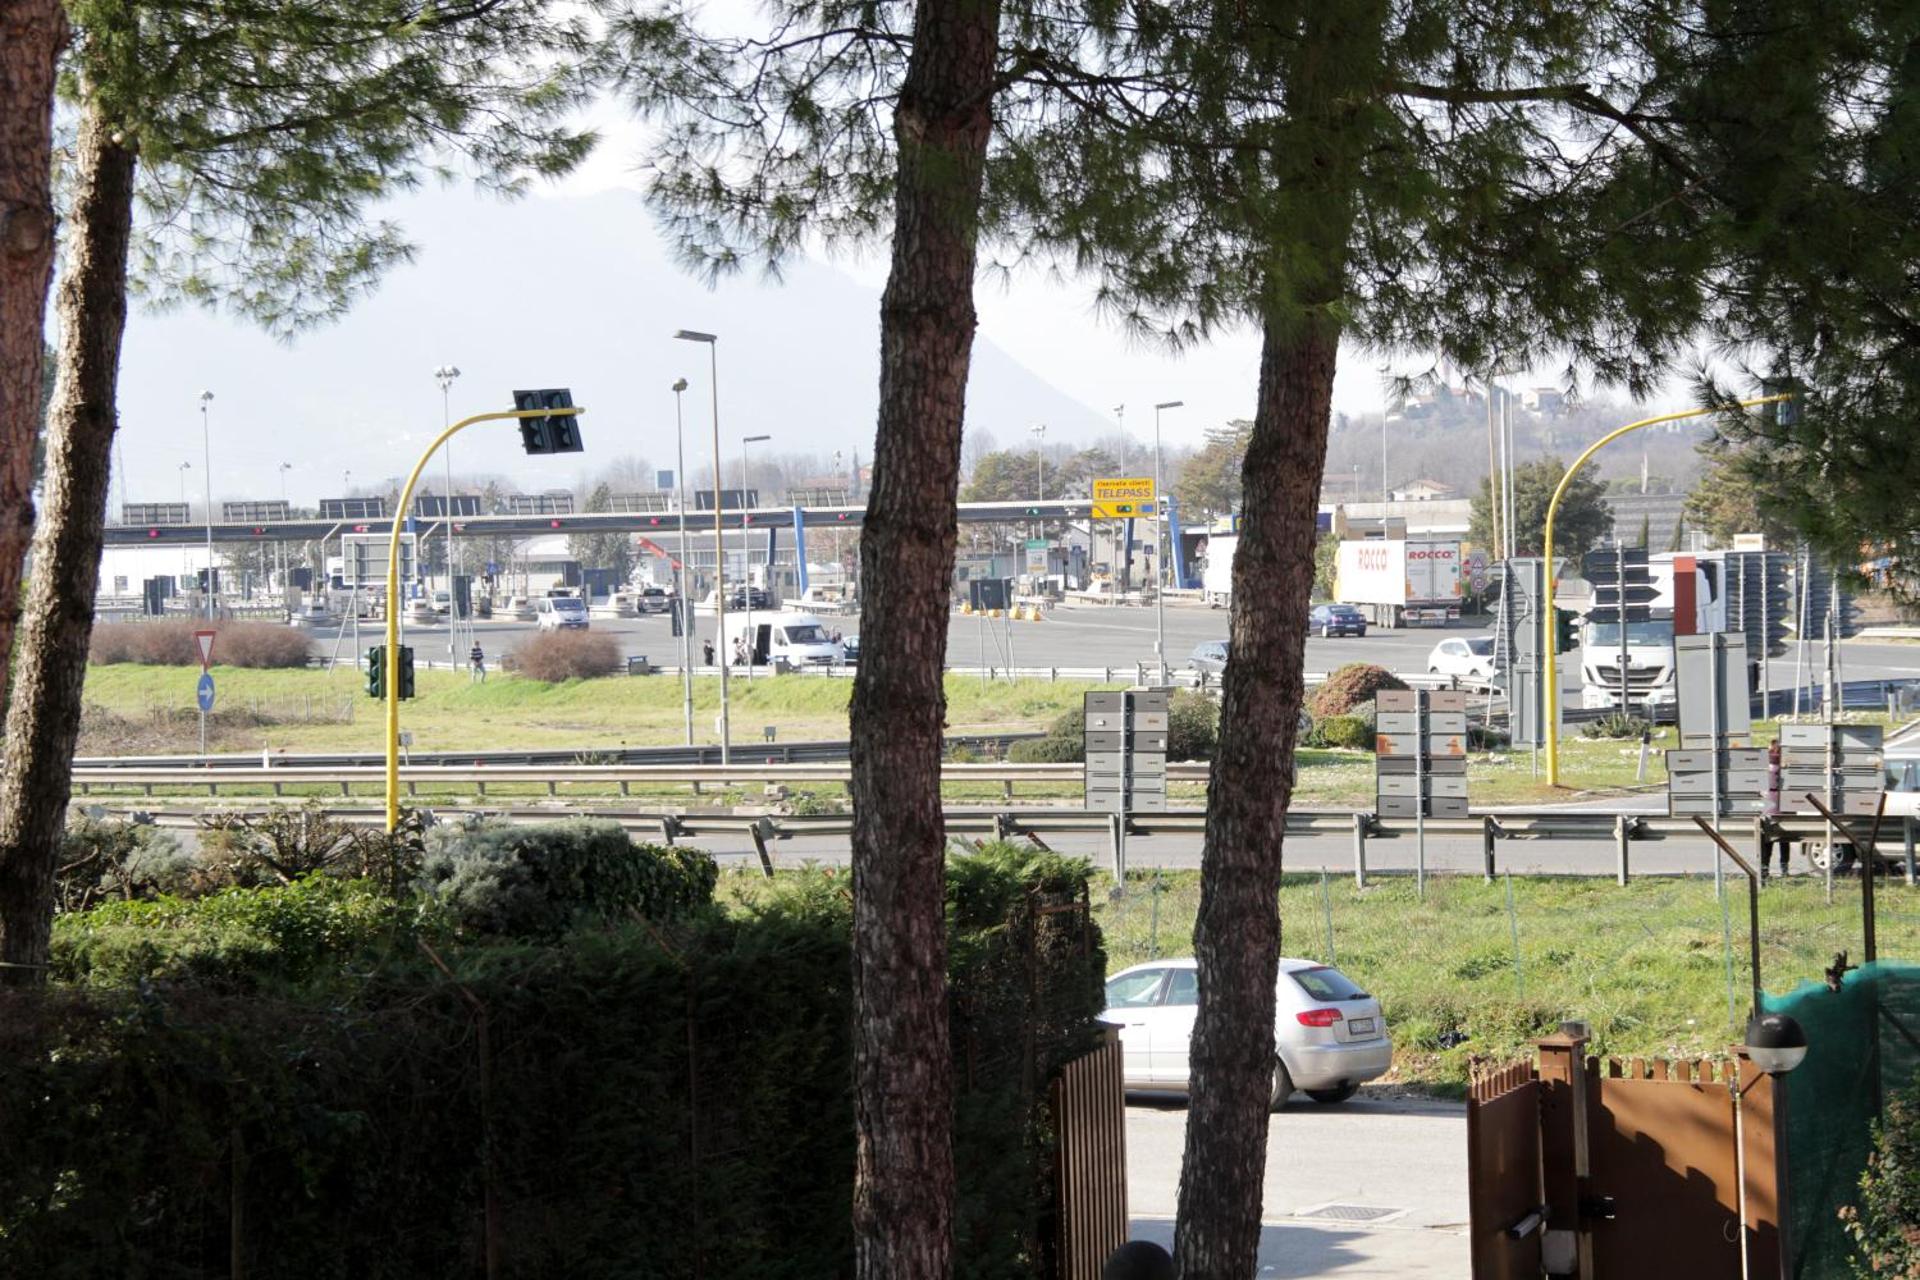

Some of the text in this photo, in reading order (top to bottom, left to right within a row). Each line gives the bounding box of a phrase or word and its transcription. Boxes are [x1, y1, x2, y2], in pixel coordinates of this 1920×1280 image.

[1097, 488, 1151, 499] TELEPASS
[1358, 548, 1387, 570] ROCCO
[1408, 550, 1454, 559] ROCCO
